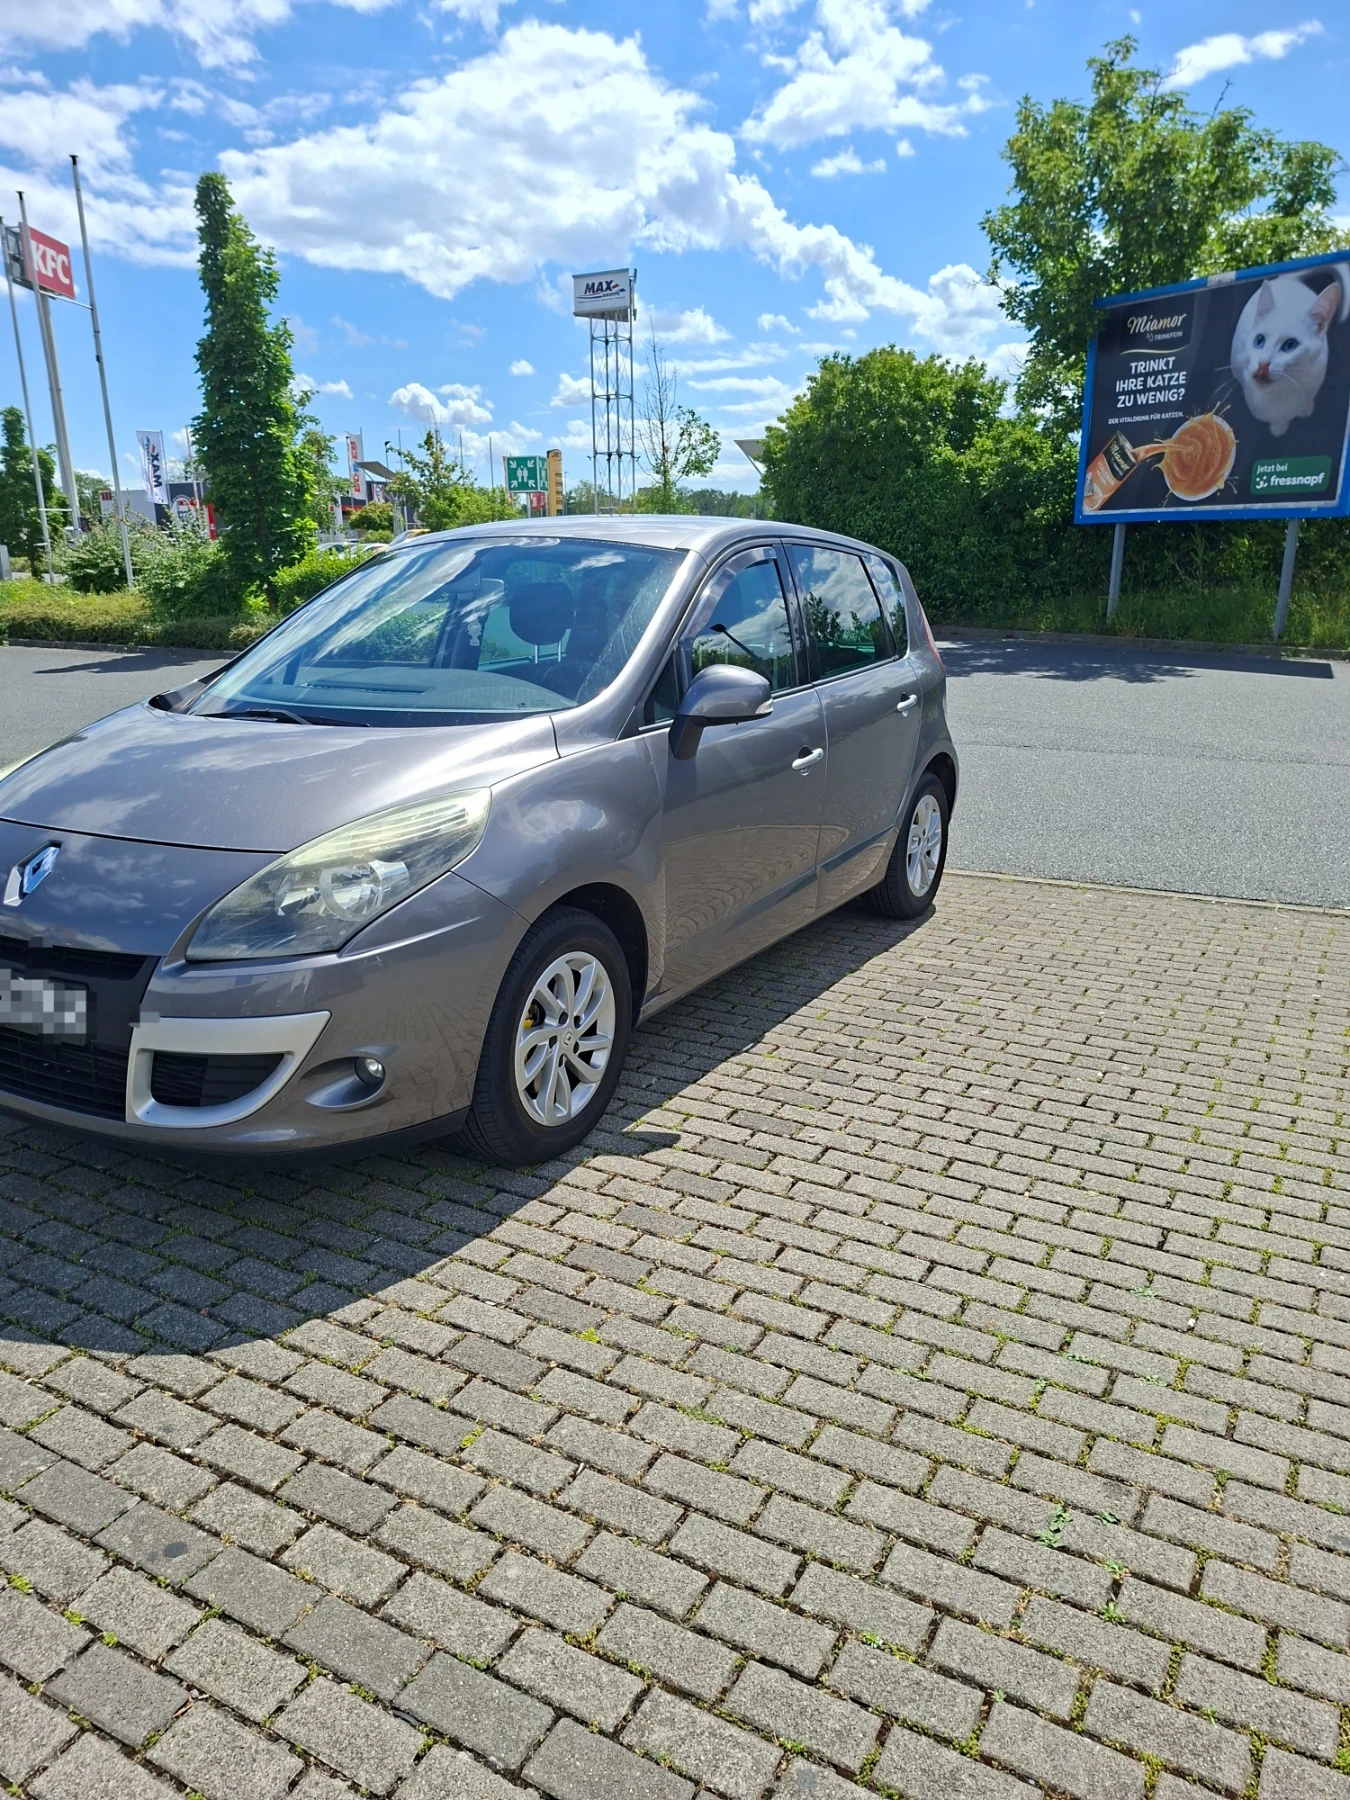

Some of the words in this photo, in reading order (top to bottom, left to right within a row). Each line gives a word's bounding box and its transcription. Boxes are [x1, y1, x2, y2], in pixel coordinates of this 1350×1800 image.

[30, 239, 70, 285] KFC
[584, 280, 614, 294] MAX
[1127, 313, 1187, 335] Miamor
[1154, 331, 1183, 341] TRINKFEIN
[1130, 356, 1176, 375] TRINKT
[1116, 377, 1144, 393] IHRE
[1147, 371, 1187, 388] KATZE
[1117, 394, 1134, 408] ZU
[1136, 388, 1186, 406] WENIG?
[1150, 412, 1161, 421] FÜR
[1256, 464, 1275, 475] Jetzt
[1276, 462, 1288, 472] bei
[1270, 472, 1326, 487] fressnapf
